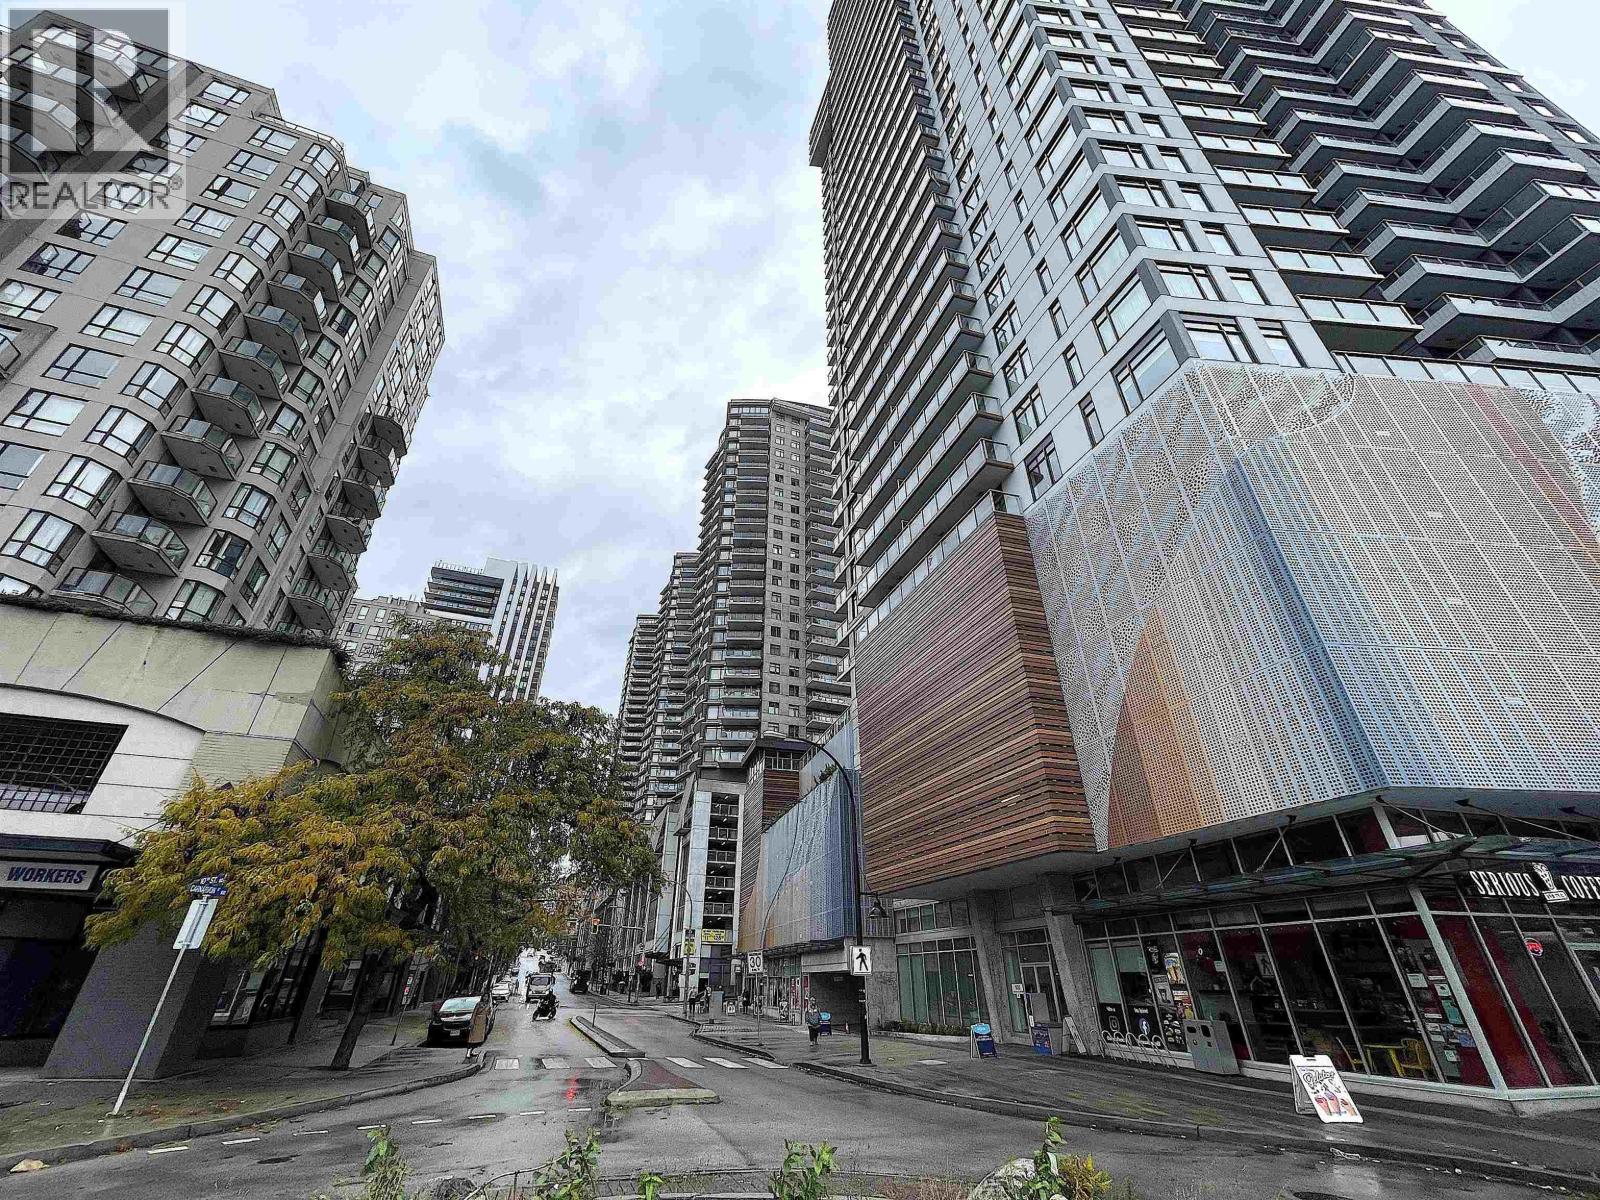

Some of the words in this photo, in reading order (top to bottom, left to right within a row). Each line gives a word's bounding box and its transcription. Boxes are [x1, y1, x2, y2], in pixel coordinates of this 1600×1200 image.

[6, 866, 87, 884] WORKERS
[1469, 870, 1540, 897] SERIOUS
[749, 956, 762, 968] 30
